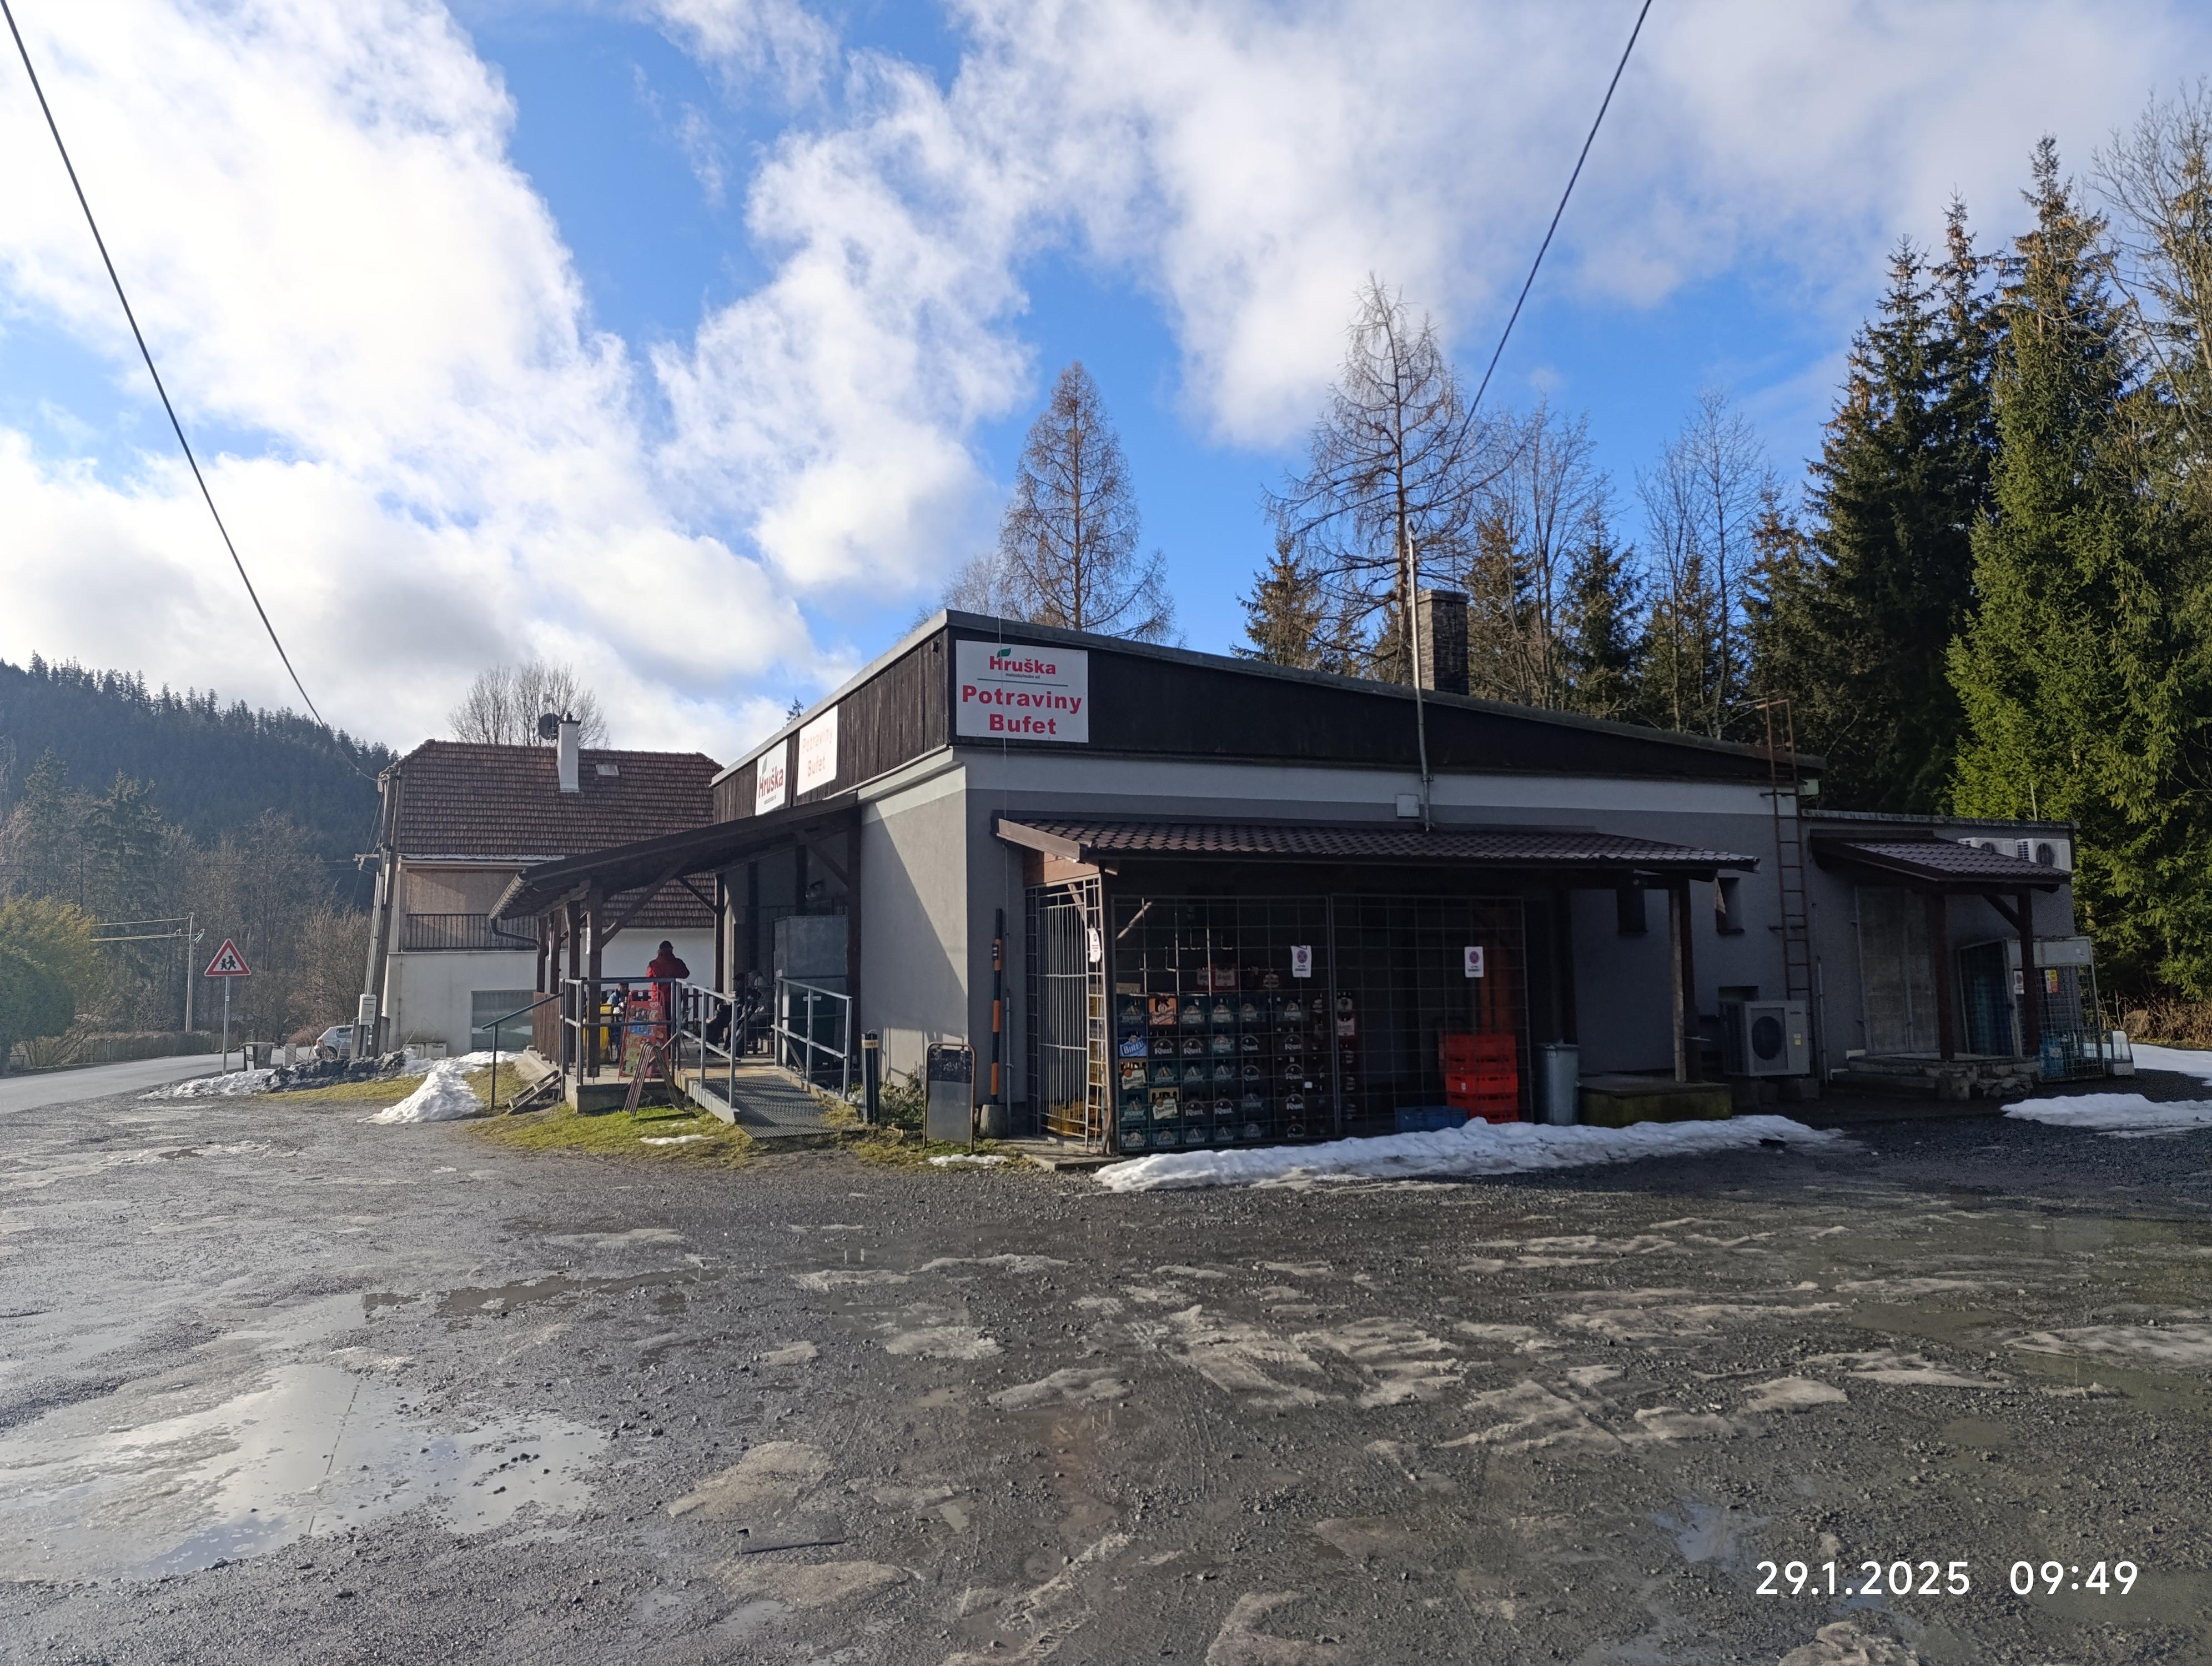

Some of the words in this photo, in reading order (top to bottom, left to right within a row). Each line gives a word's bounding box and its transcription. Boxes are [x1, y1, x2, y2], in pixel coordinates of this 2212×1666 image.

[989, 656, 1056, 675] Hruška
[962, 685, 1082, 714] Potraviny
[989, 714, 1056, 735] Bufet
[807, 755, 825, 777] Bufet
[758, 766, 783, 799] Hruška
